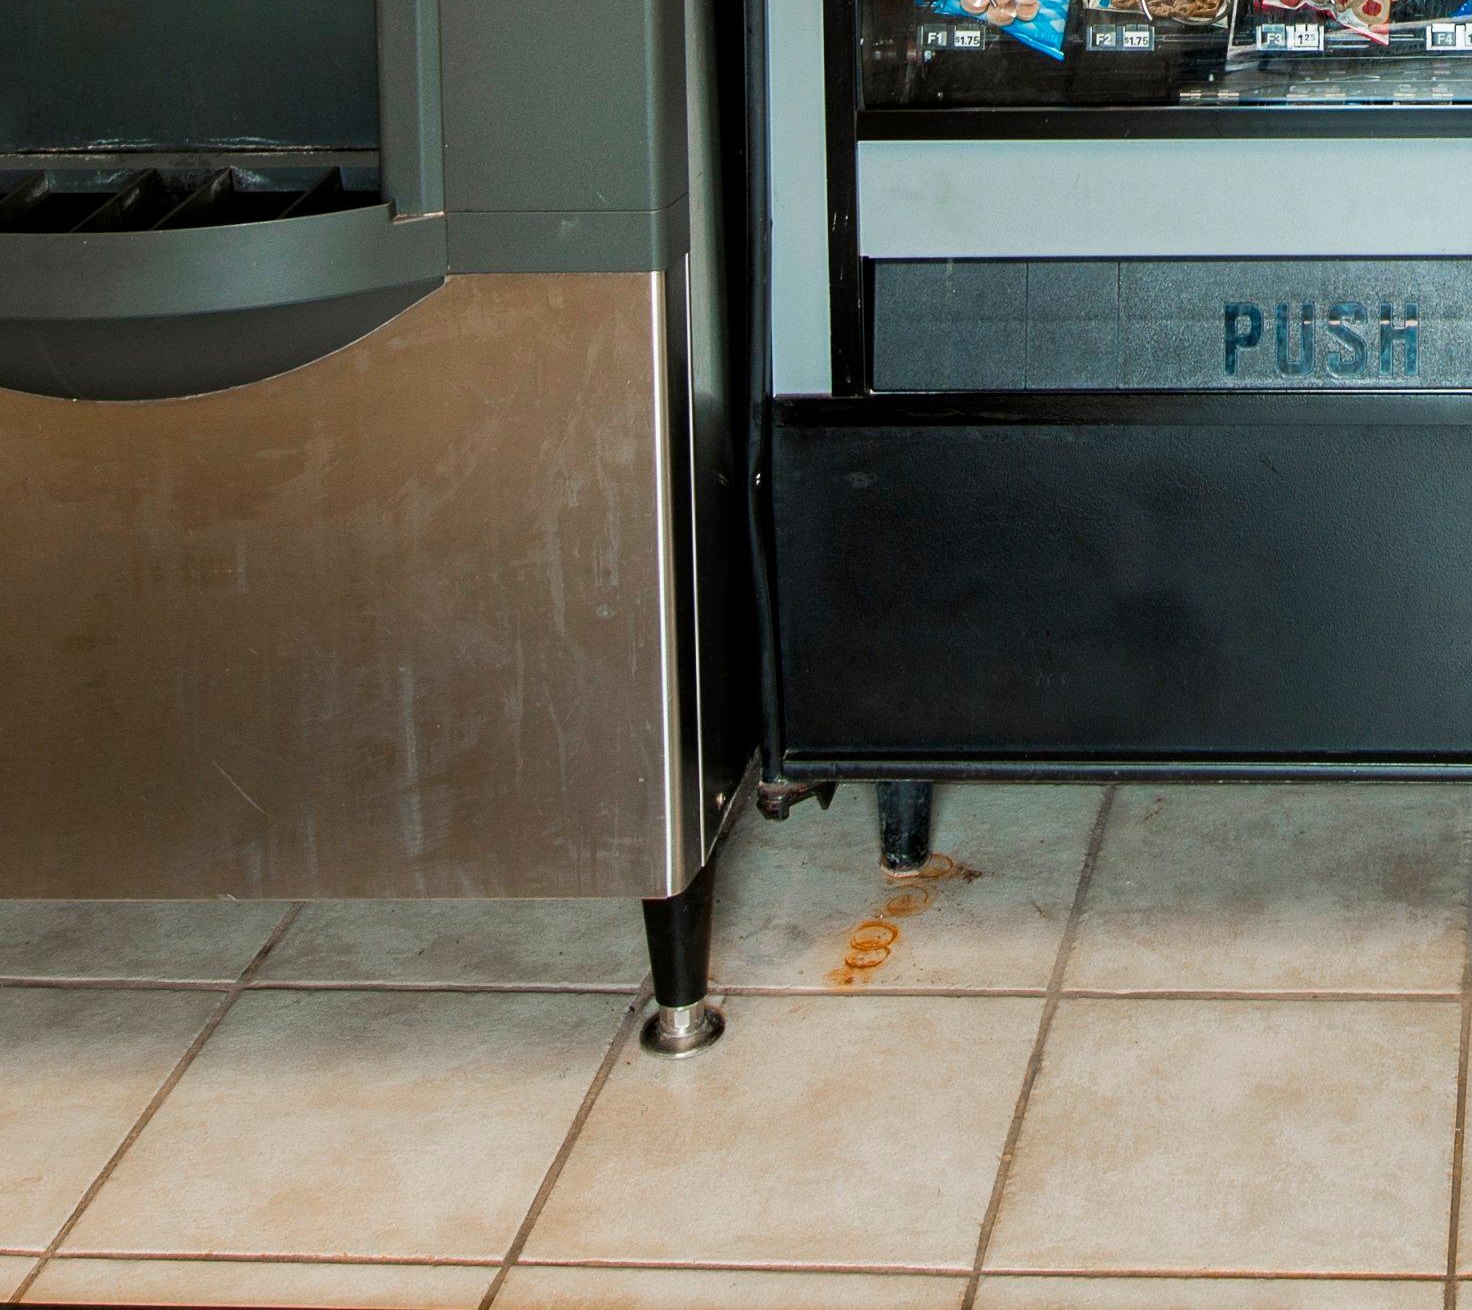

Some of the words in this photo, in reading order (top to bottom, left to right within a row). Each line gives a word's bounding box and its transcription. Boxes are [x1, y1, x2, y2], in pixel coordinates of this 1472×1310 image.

[928, 32, 942, 44] F1
[956, 36, 980, 46] $1.75
[1096, 33, 1111, 45] F2
[1124, 34, 1149, 45] $1.75
[1267, 33, 1281, 44] F3
[1438, 33, 1452, 44] F4
[1224, 301, 1419, 378] PUSH
